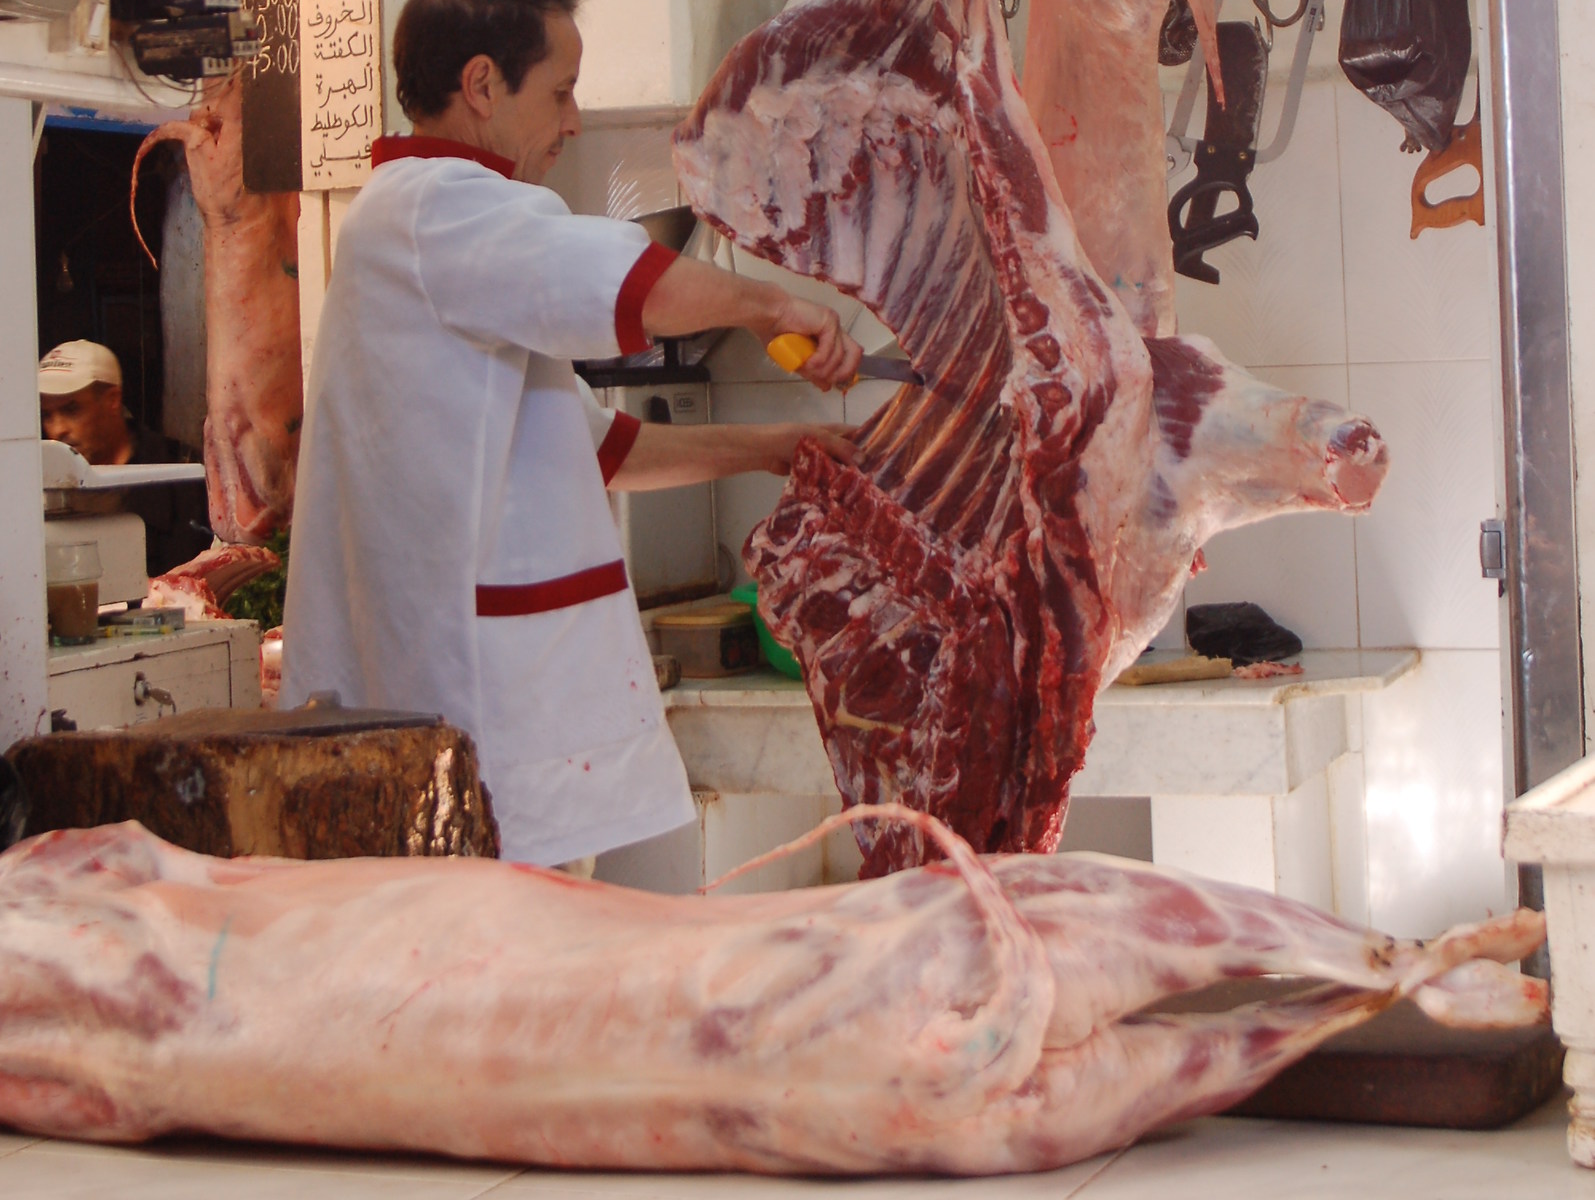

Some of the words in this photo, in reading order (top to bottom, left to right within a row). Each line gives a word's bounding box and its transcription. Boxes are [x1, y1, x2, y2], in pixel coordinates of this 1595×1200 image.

[307, 0, 373, 39] الخروف
[313, 31, 373, 60] الكفتة
[310, 104, 374, 140] الكوطليط
